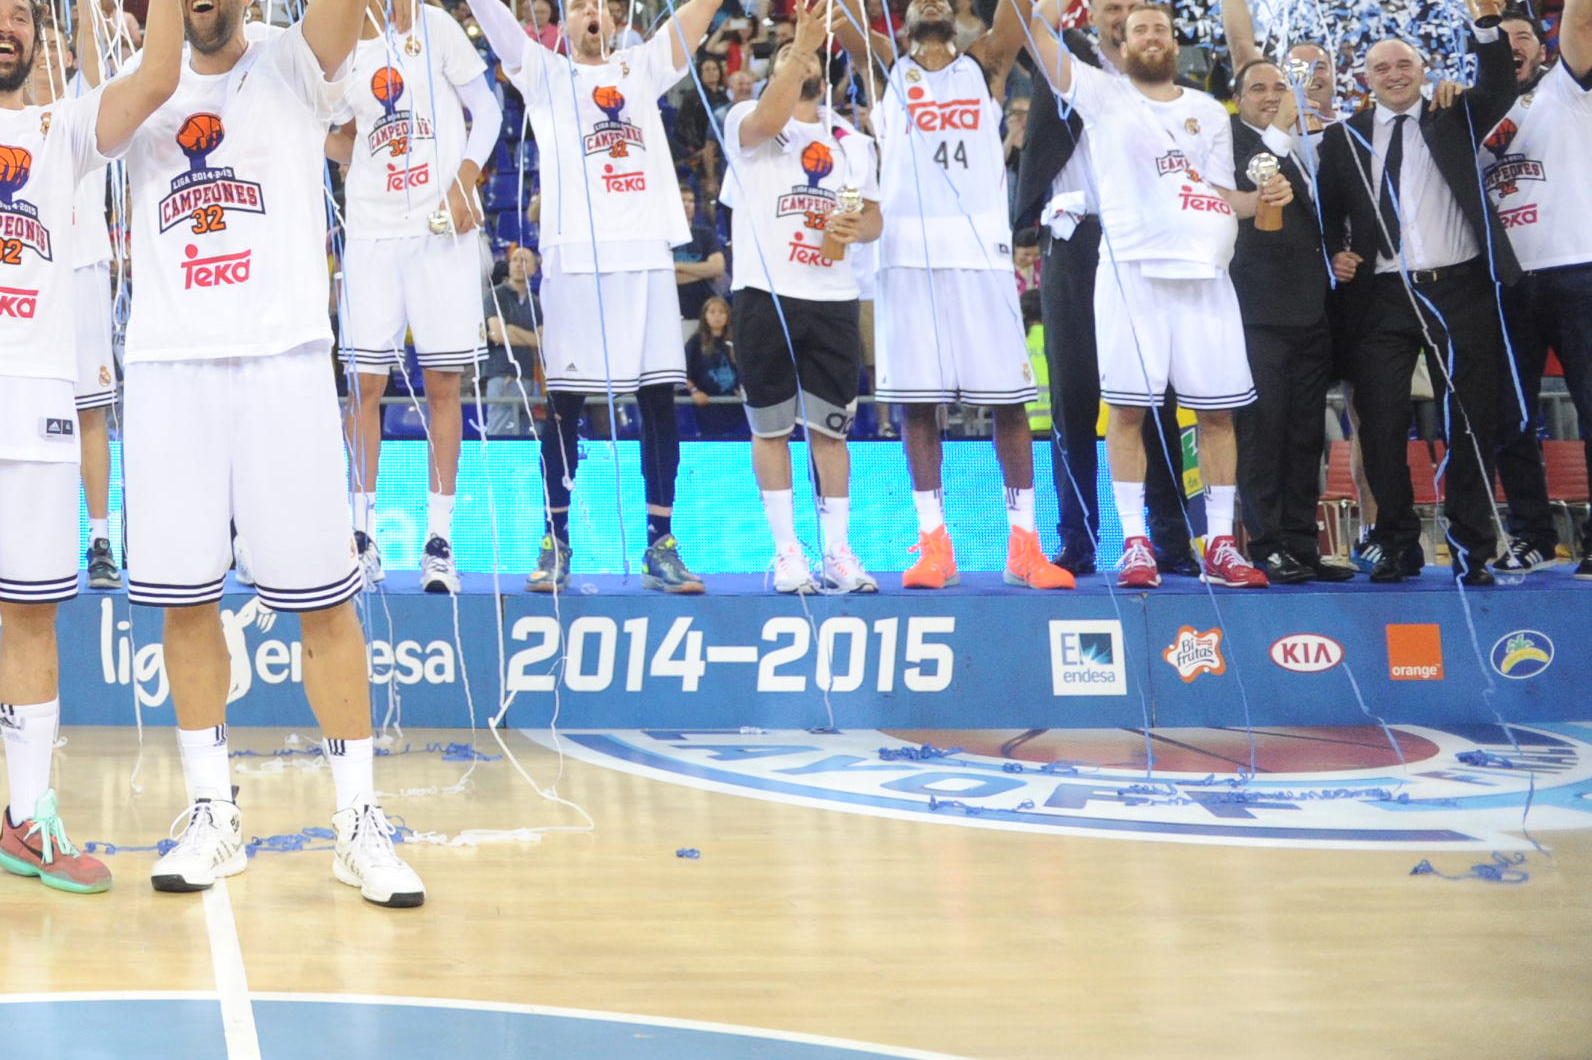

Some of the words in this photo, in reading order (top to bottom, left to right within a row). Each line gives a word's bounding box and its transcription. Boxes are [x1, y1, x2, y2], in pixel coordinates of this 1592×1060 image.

[933, 140, 969, 170] 44
[163, 182, 258, 224] CAMPEONES
[781, 197, 836, 212] CAMPEO
[190, 204, 227, 235] 32
[804, 211, 825, 230] 32
[100, 597, 171, 707] lig
[1181, 638, 1194, 653] Bi
[1282, 643, 1333, 663] KIA
[1177, 648, 1214, 667] frutas
[1063, 668, 1116, 683] endesa
